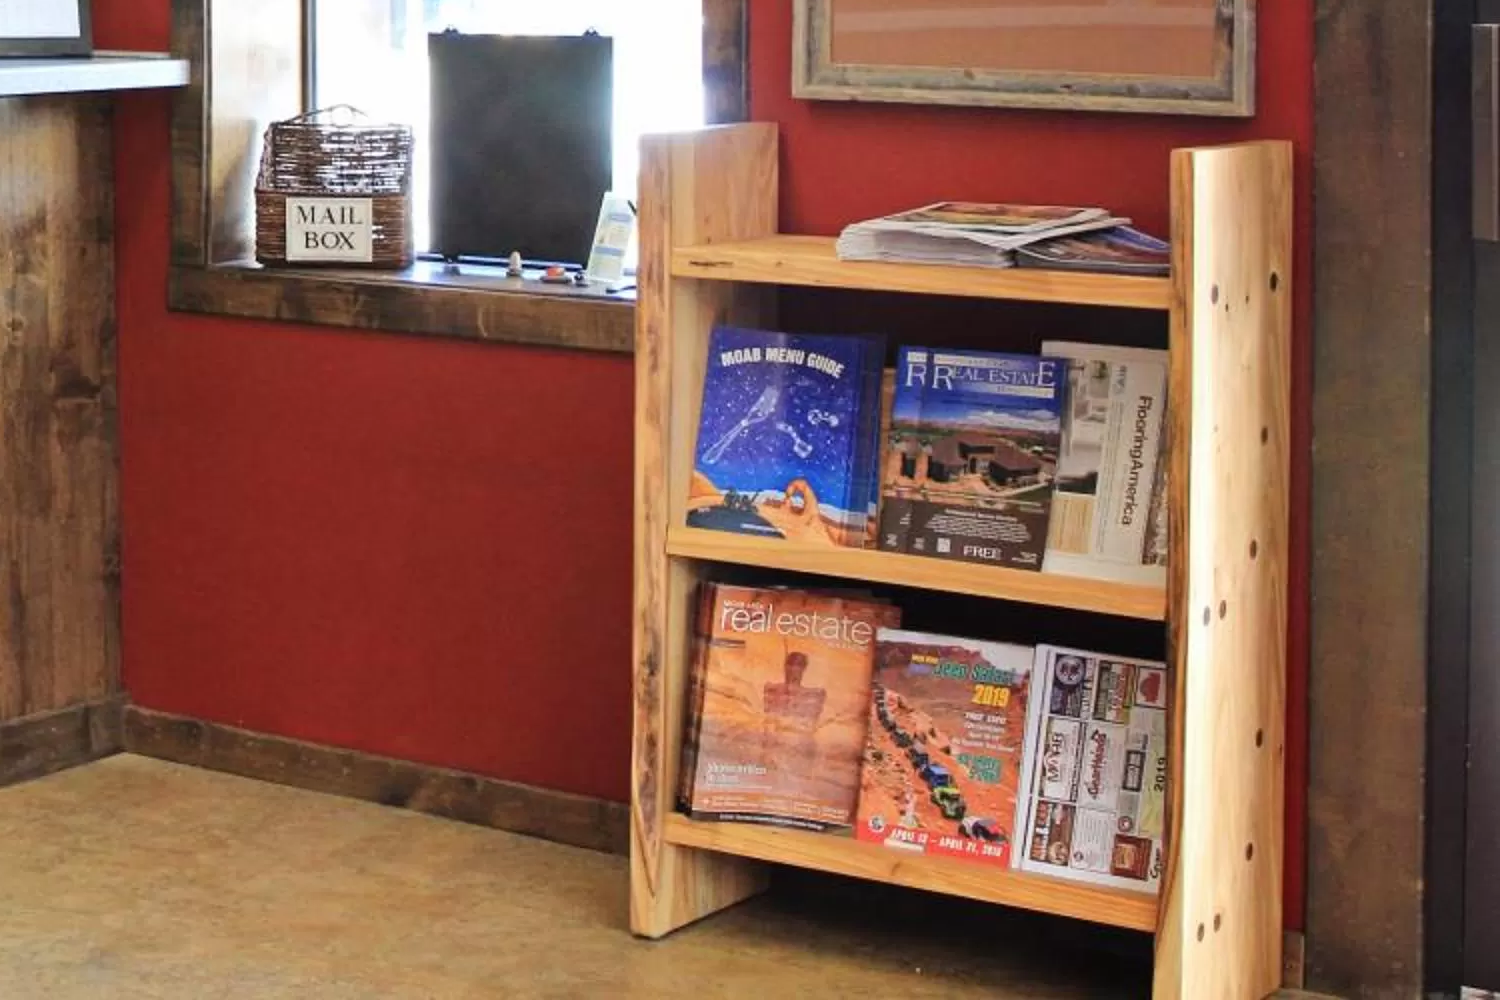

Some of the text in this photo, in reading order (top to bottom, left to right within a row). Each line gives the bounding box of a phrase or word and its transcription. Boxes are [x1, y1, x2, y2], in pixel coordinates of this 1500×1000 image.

[297, 205, 364, 225] MAIL
[304, 231, 355, 250] BOX
[721, 347, 845, 379] MOAB MENU GUIDE
[931, 365, 984, 391] REAL
[989, 361, 1056, 387] ESTATE
[1122, 395, 1152, 526] FlooringAmerica
[963, 545, 1002, 560] FREE
[721, 603, 873, 646] real estate
[972, 684, 1011, 708] 2019
[1154, 757, 1168, 792] 2019
[939, 836, 963, 850] APRIL
